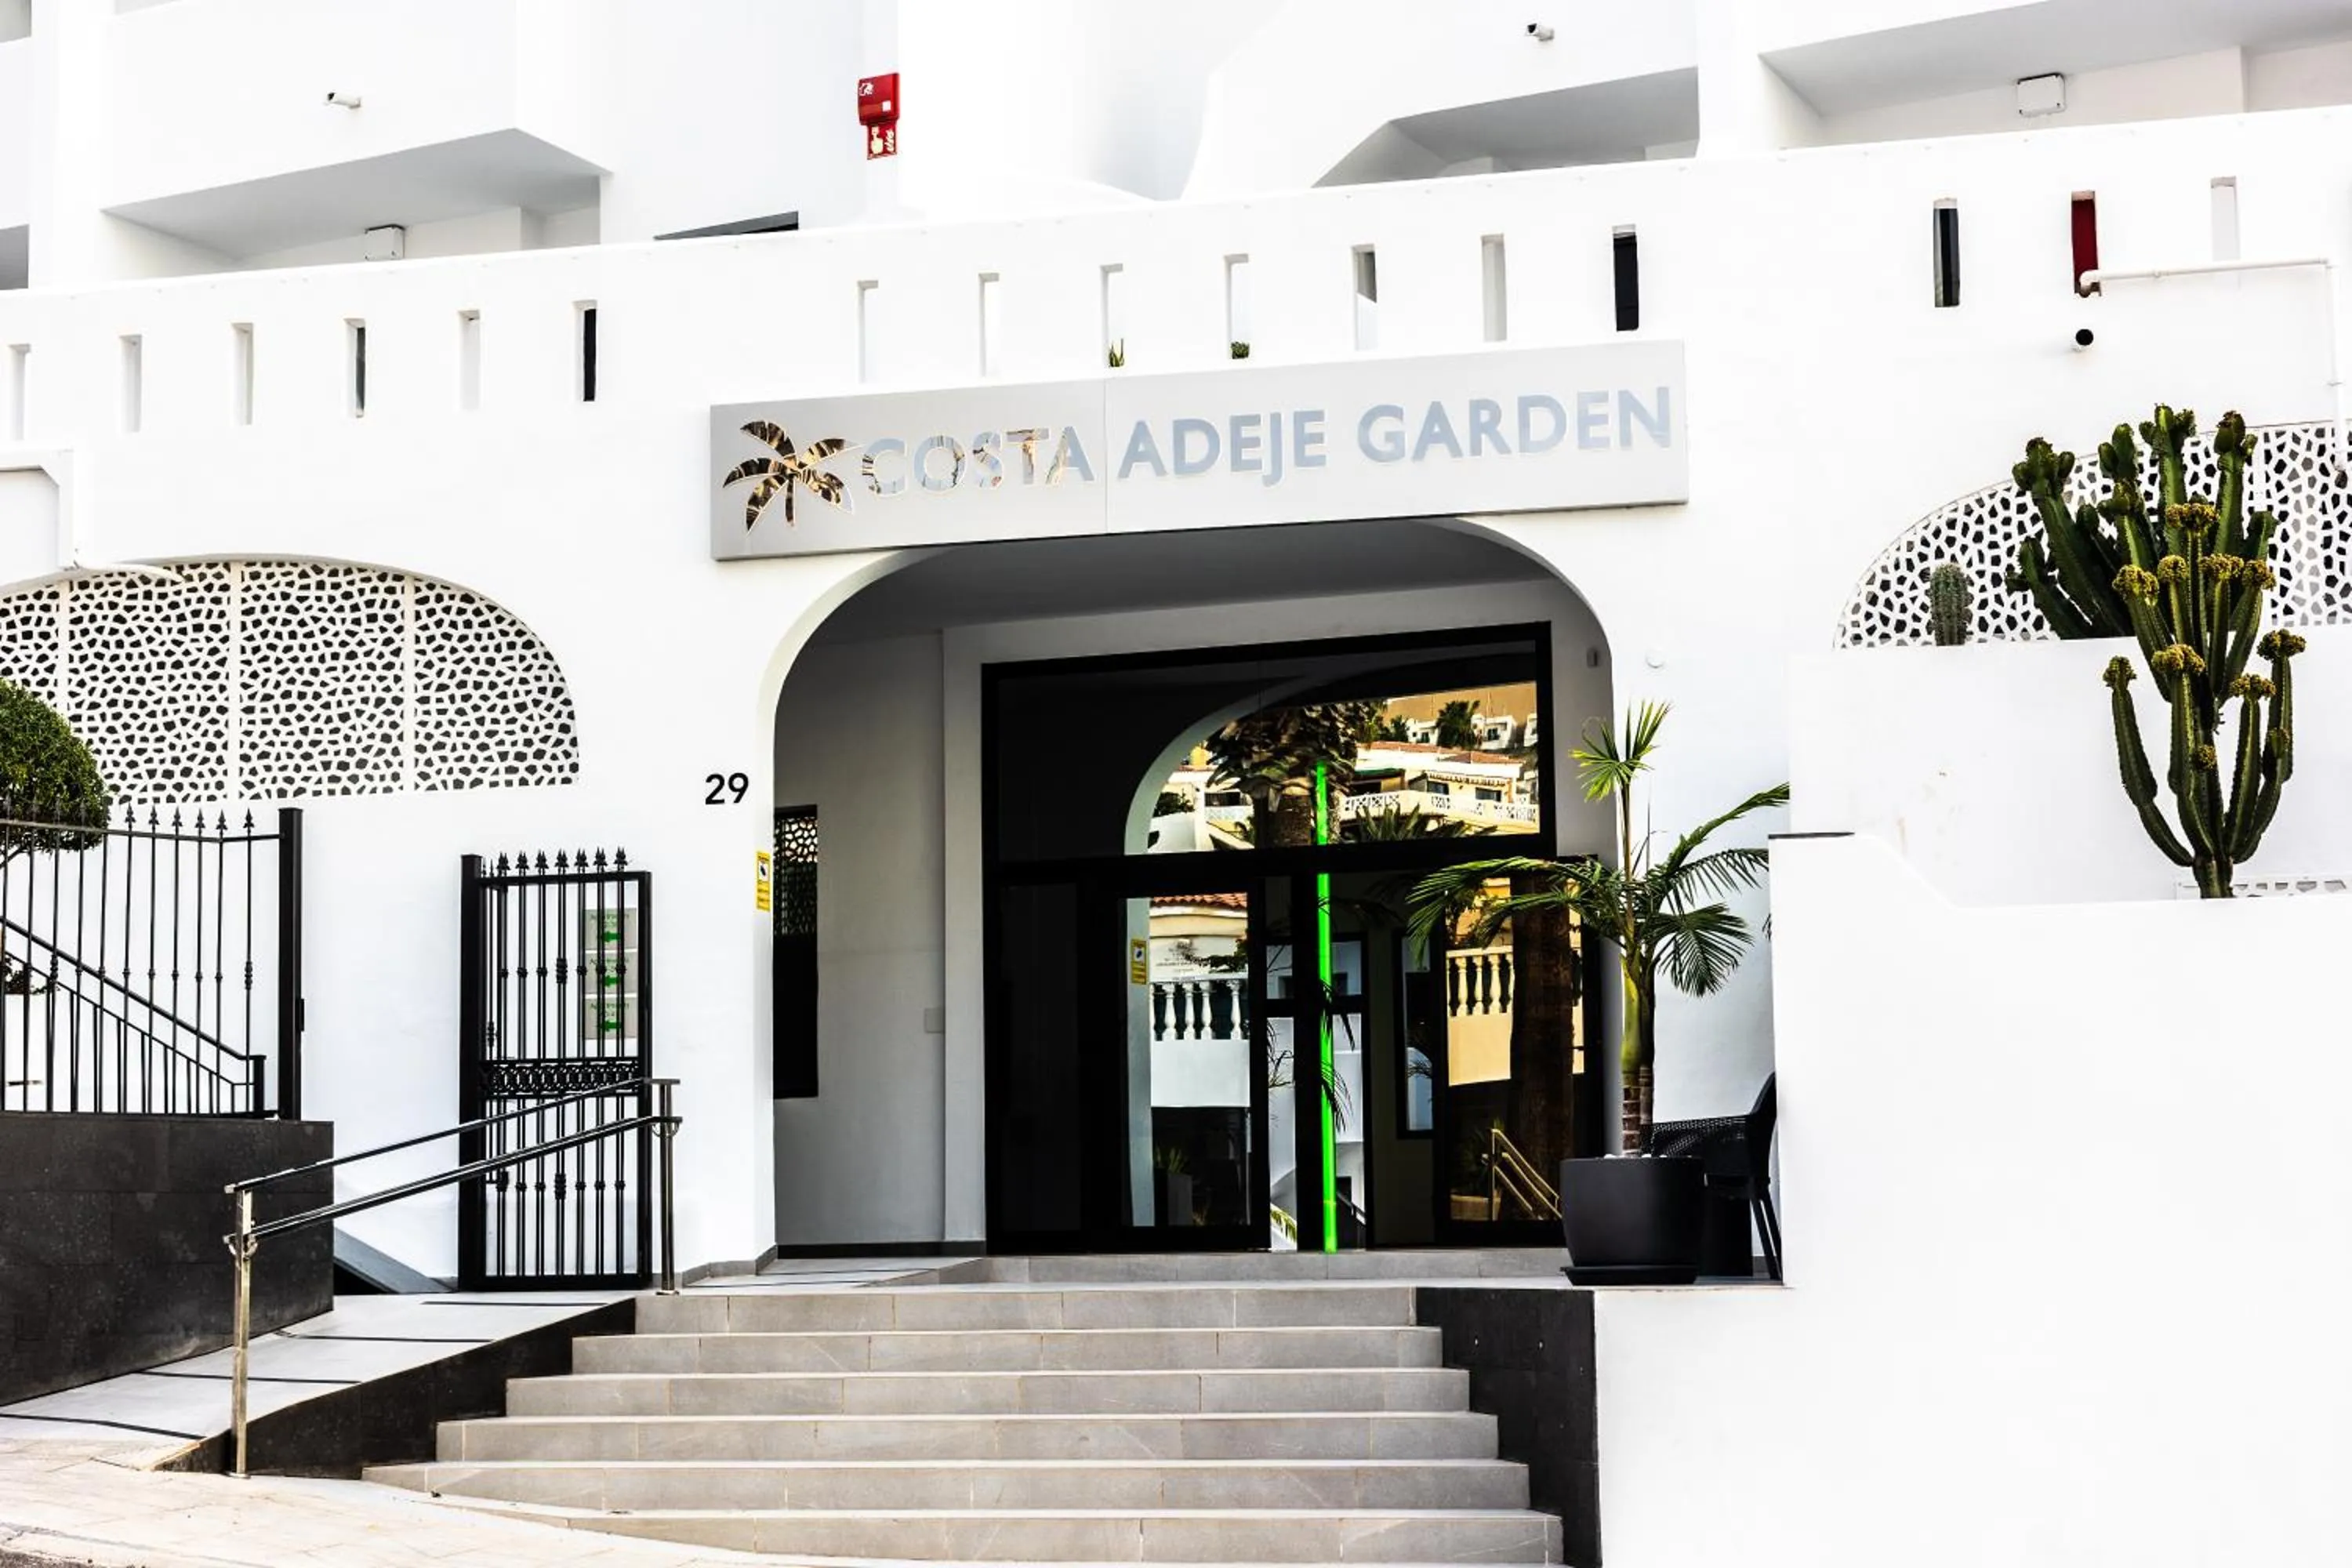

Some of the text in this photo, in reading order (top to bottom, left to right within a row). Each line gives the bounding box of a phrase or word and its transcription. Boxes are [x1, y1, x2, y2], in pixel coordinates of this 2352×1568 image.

[862, 387, 1671, 495] COSTA ADEJE GARDEN
[705, 773, 749, 804] 29
